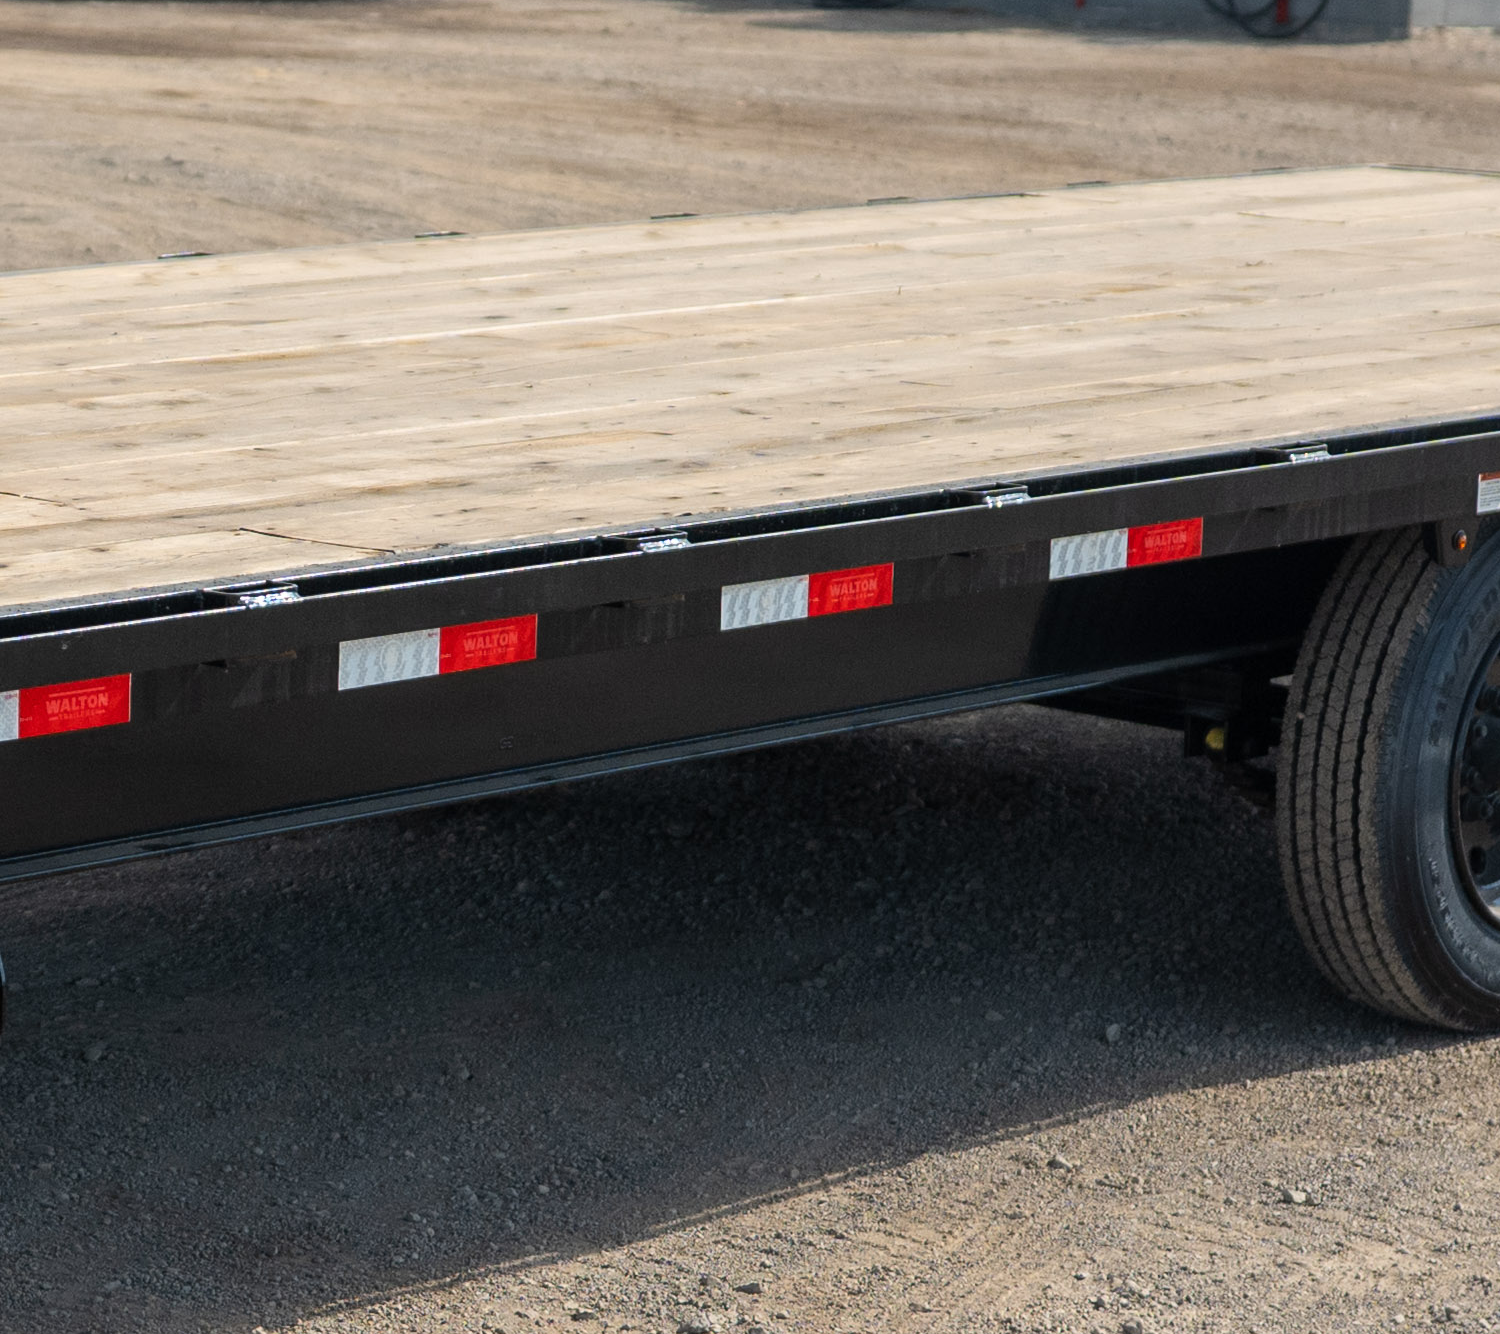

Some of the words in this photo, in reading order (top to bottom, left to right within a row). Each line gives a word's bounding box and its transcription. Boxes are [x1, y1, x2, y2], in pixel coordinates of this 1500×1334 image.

[1144, 530, 1187, 549] WALTON
[830, 578, 879, 597] WALTON
[463, 631, 519, 652] WALTON
[45, 692, 109, 714] WALTON
